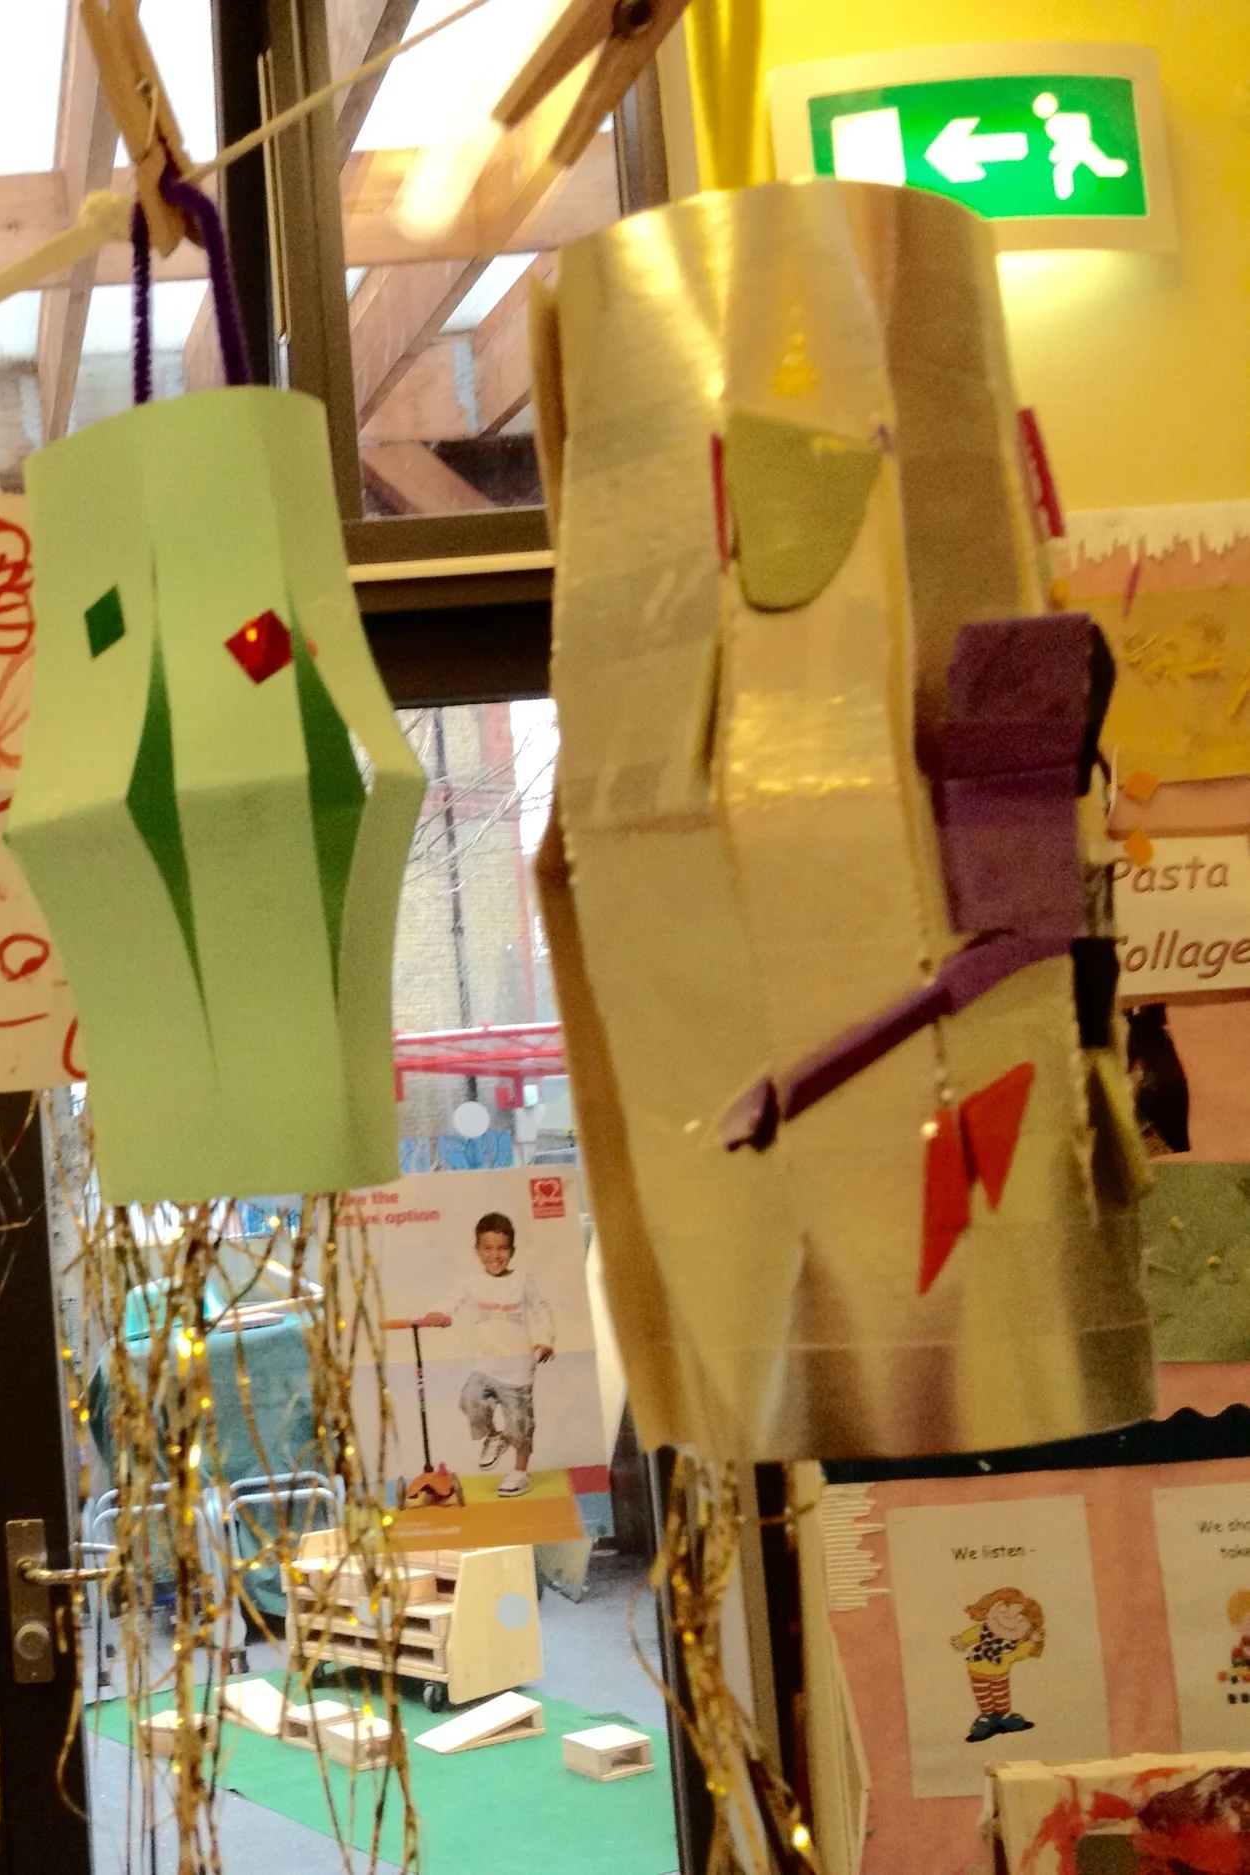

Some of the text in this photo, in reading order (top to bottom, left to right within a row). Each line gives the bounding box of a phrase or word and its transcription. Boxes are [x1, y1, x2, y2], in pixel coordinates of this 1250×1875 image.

[1110, 856, 1229, 893] Pasta
[1115, 929, 1250, 979] ollage
[371, 1190, 399, 1205] the
[385, 1209, 440, 1227] option
[951, 1546, 978, 1561] We
[982, 1544, 1026, 1559] listen
